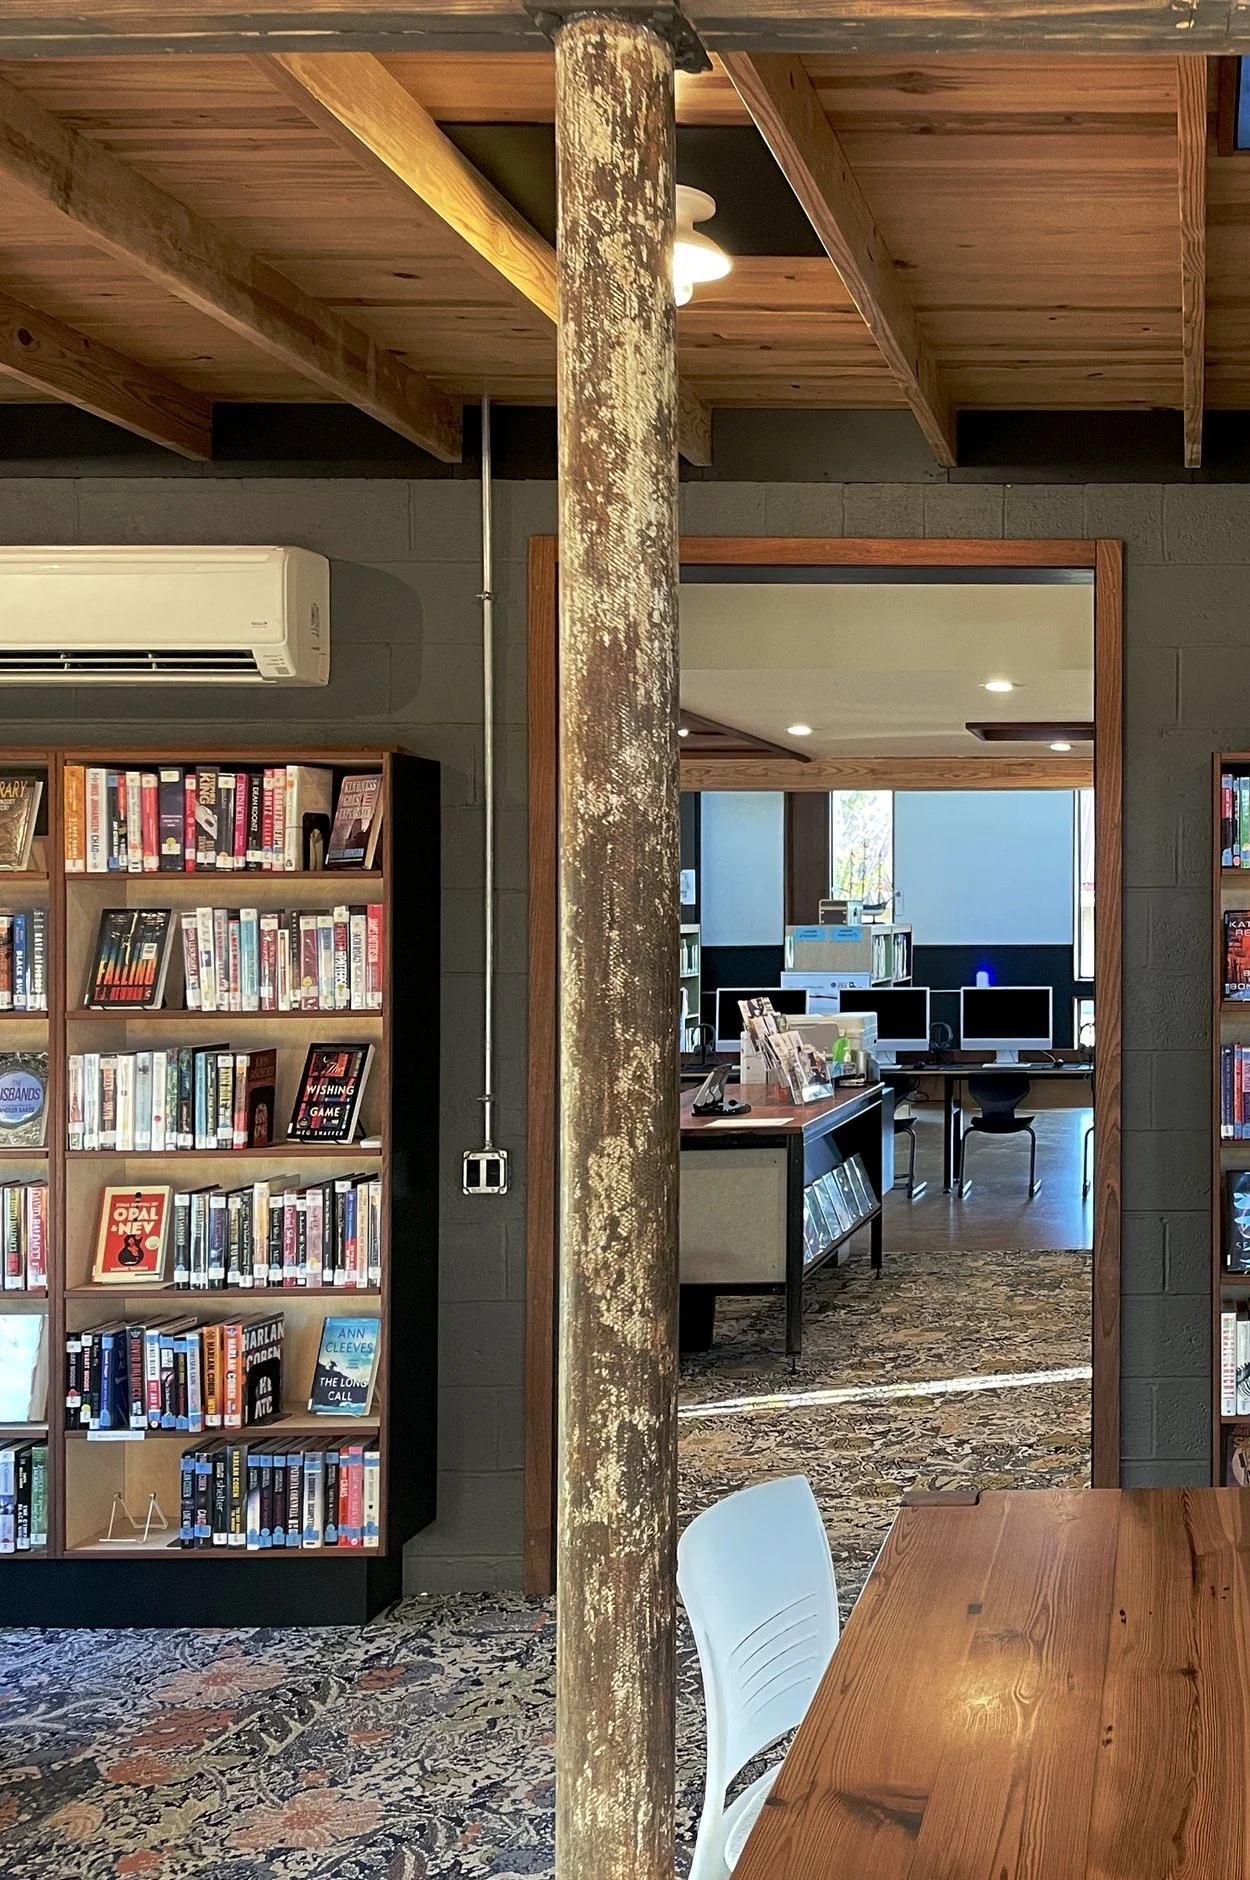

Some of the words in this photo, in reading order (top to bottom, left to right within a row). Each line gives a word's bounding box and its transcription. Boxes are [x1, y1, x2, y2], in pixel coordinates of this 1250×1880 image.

[198, 772, 209, 805] KING
[251, 787, 260, 805] DEAN
[251, 806, 260, 832] KOONTZ
[91, 835, 100, 853] CHAO
[16, 950, 24, 976] BLACK
[16, 979, 24, 994] BUC
[306, 1085, 355, 1095] WISHING
[309, 1106, 341, 1117] GAME
[113, 1207, 159, 1221] OPAL
[272, 1208, 280, 1224] Daniel
[285, 1207, 294, 1228] Daniel
[118, 1221, 155, 1235] NEV
[242, 1321, 284, 1352] HARLAN
[338, 1328, 365, 1339] ANN
[206, 1342, 216, 1371] HARLAN
[226, 1338, 236, 1370] HARLAN
[325, 1342, 374, 1353] CLEEVES
[226, 1372, 236, 1398] COBEN
[320, 1377, 338, 1387] THE
[340, 1378, 368, 1388] LONG
[327, 1391, 353, 1401] CALL
[232, 1450, 241, 1476] HARLAN
[216, 1480, 225, 1511] shelter
[232, 1477, 241, 1497] COBEN
